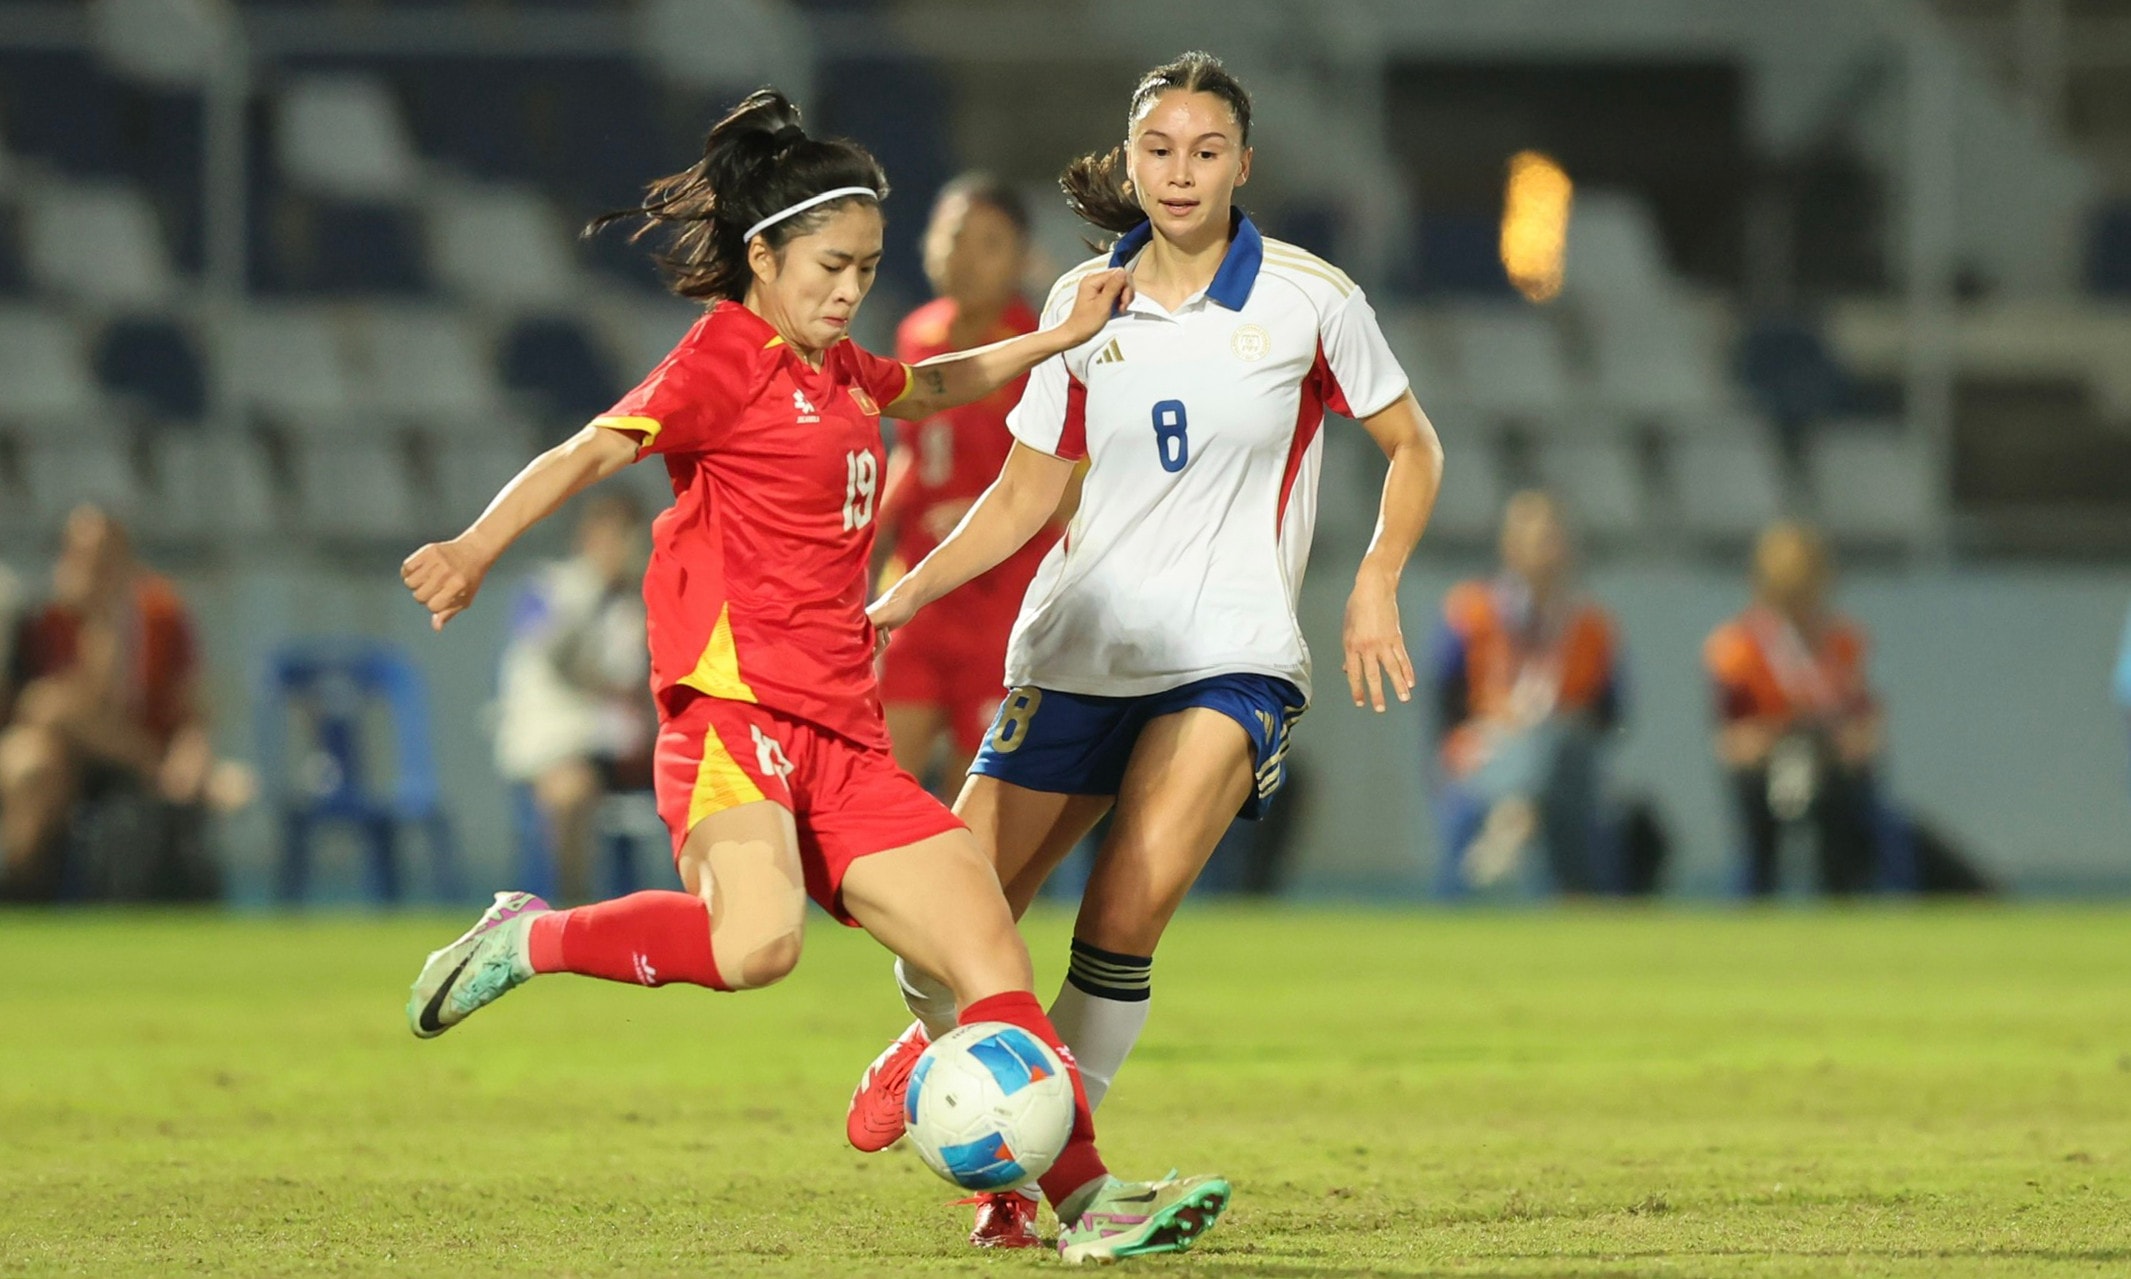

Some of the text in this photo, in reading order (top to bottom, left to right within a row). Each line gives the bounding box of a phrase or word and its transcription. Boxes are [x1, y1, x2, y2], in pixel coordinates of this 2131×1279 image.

[1152, 399, 1188, 473] 8
[843, 448, 877, 531] 19
[992, 687, 1043, 753] 8
